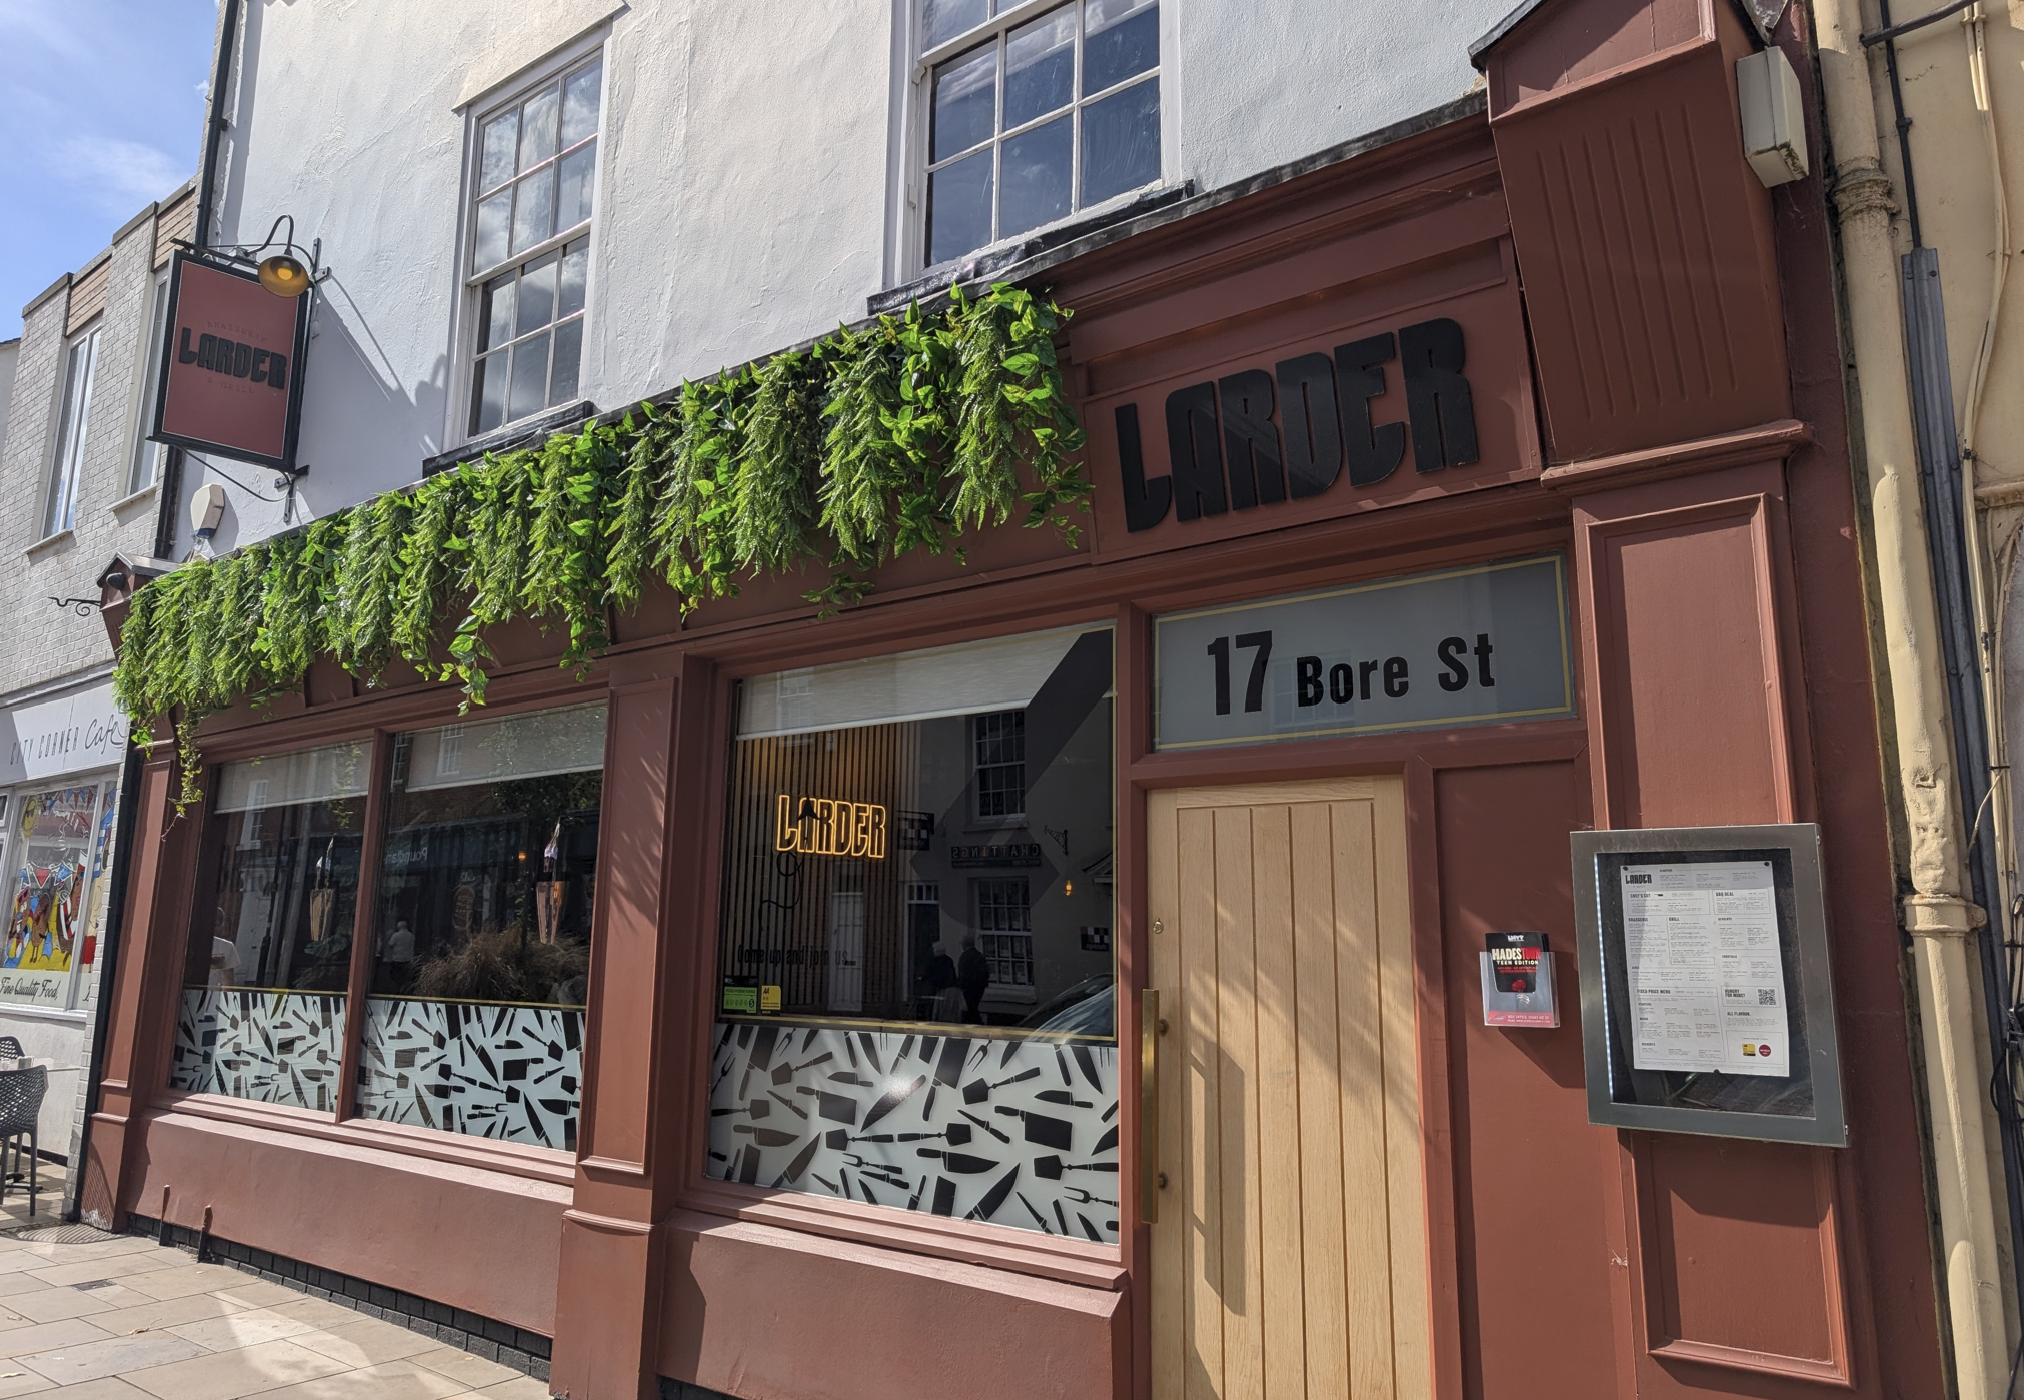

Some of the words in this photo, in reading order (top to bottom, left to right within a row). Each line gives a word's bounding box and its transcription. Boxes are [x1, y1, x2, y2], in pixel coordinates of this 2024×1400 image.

[206, 320, 268, 344] BRASSERIE
[178, 327, 288, 390] LARDER
[220, 382, 255, 394] GRILL
[1114, 316, 1480, 533] LARDER
[1207, 630, 1273, 716] 17
[1296, 655, 1409, 708] Bore
[1437, 632, 1495, 693] St
[38, 726, 79, 759] CORNER
[775, 794, 886, 859] LARDER
[1625, 874, 1652, 884] LARDER
[0, 977, 14, 995] Fine
[15, 978, 40, 1002] Quality
[762, 987, 770, 995] AA
